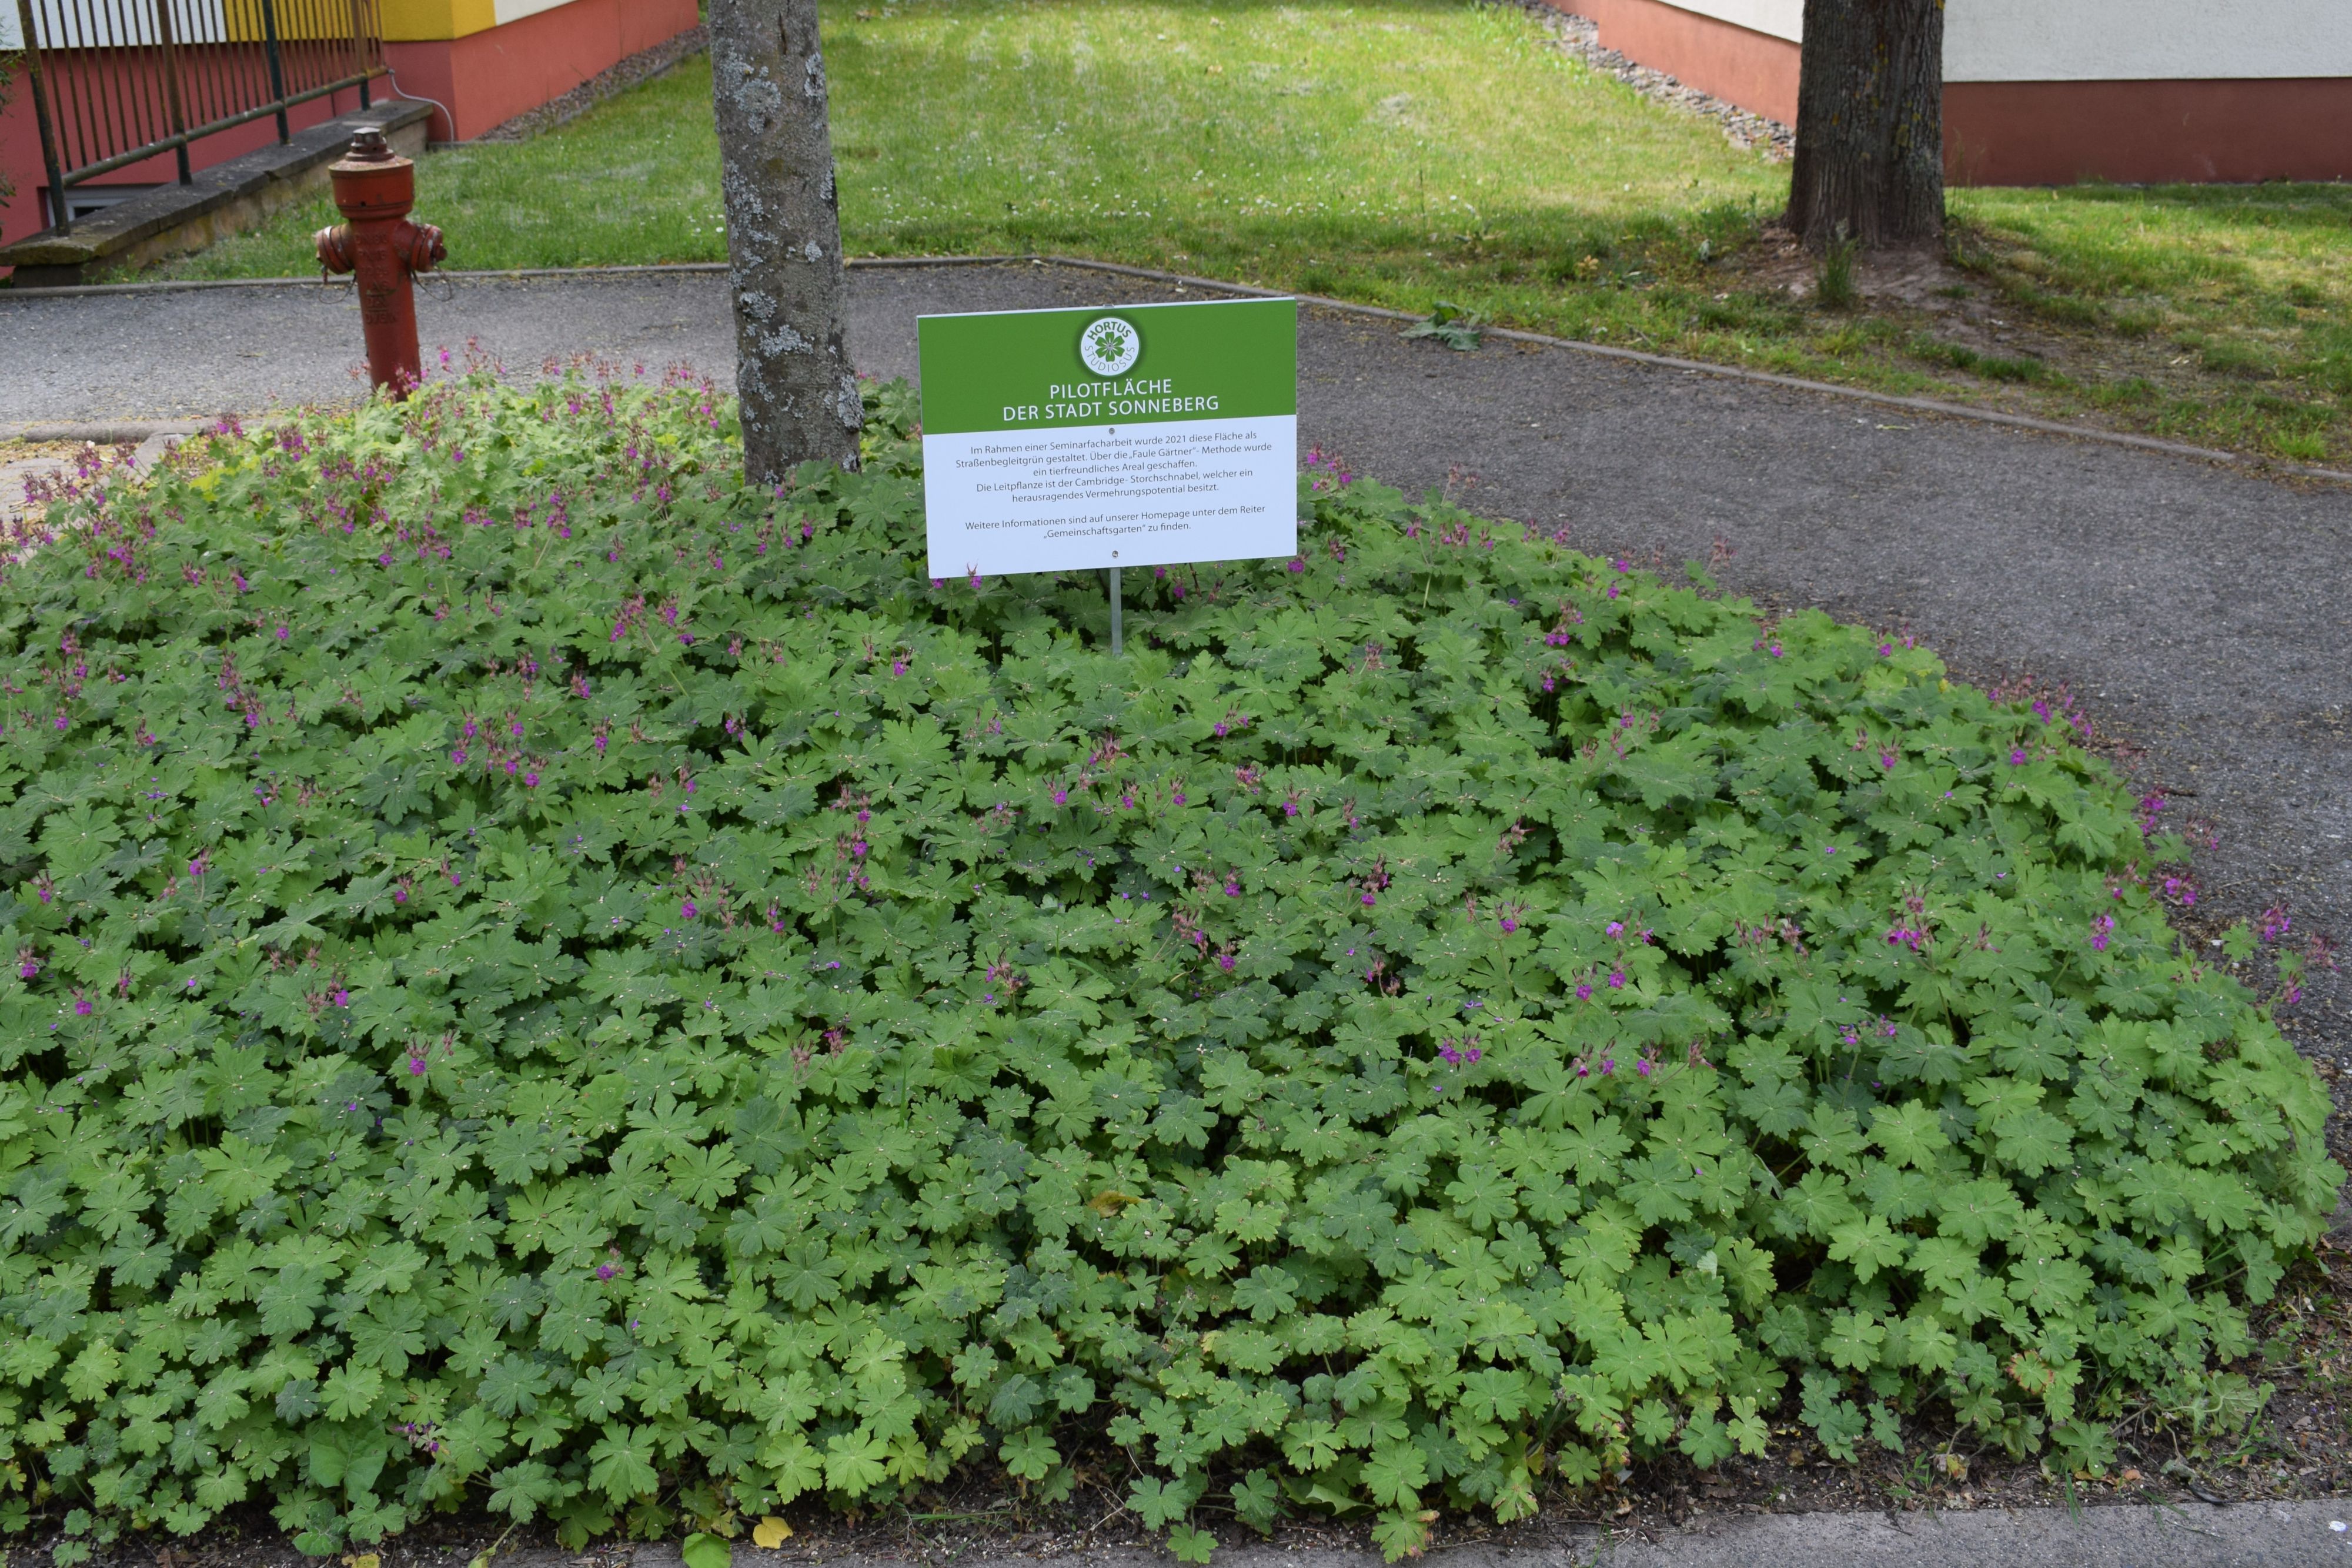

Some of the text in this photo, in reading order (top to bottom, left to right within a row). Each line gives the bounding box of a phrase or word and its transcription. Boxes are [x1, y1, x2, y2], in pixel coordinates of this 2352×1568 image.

[1087, 321, 1132, 340] HORTUS
[1084, 345, 1135, 372] STUDIOSUS
[1050, 378, 1172, 399] PILOTFLÄCHE
[1004, 396, 1218, 421] DER STADT SONNEBERG
[985, 445, 1022, 453] Rahmen
[1025, 443, 1047, 452] einer
[1050, 438, 1132, 450] Seminarfacharbeit
[1135, 436, 1162, 445] wurde
[1165, 435, 1185, 444] 2021
[1189, 434, 1212, 442] diese
[1215, 432, 1243, 441] Fläche
[1245, 431, 1257, 439] als
[956, 457, 1043, 468] Straßenbegleitgrün
[1046, 453, 1087, 465] gestaltet.
[1090, 452, 1111, 460] Über
[1114, 451, 1128, 459] die
[1202, 444, 1241, 454] Methode
[1244, 442, 1272, 452] wurde
[1033, 460, 1197, 476] ein tierfreundliches Areal geschaffen.
[977, 484, 991, 492] Die
[994, 482, 1043, 492] Leitpflanze
[1058, 479, 1073, 487] der
[1075, 476, 1128, 486] Cambridge-
[1131, 472, 1200, 483] Storchschnabel,
[1202, 470, 1237, 479] welcher
[1240, 469, 1252, 477] ein
[1013, 484, 1218, 502] herausragendes Vermehrungspotential besitzt.
[965, 521, 1000, 530] Weitere
[1002, 518, 1066, 529] Informationen
[1068, 515, 1087, 524] sind
[1090, 514, 1104, 523] auf
[1141, 511, 1190, 520] Homepage
[1218, 507, 1237, 515] dem
[1161, 522, 1191, 530] finden.
